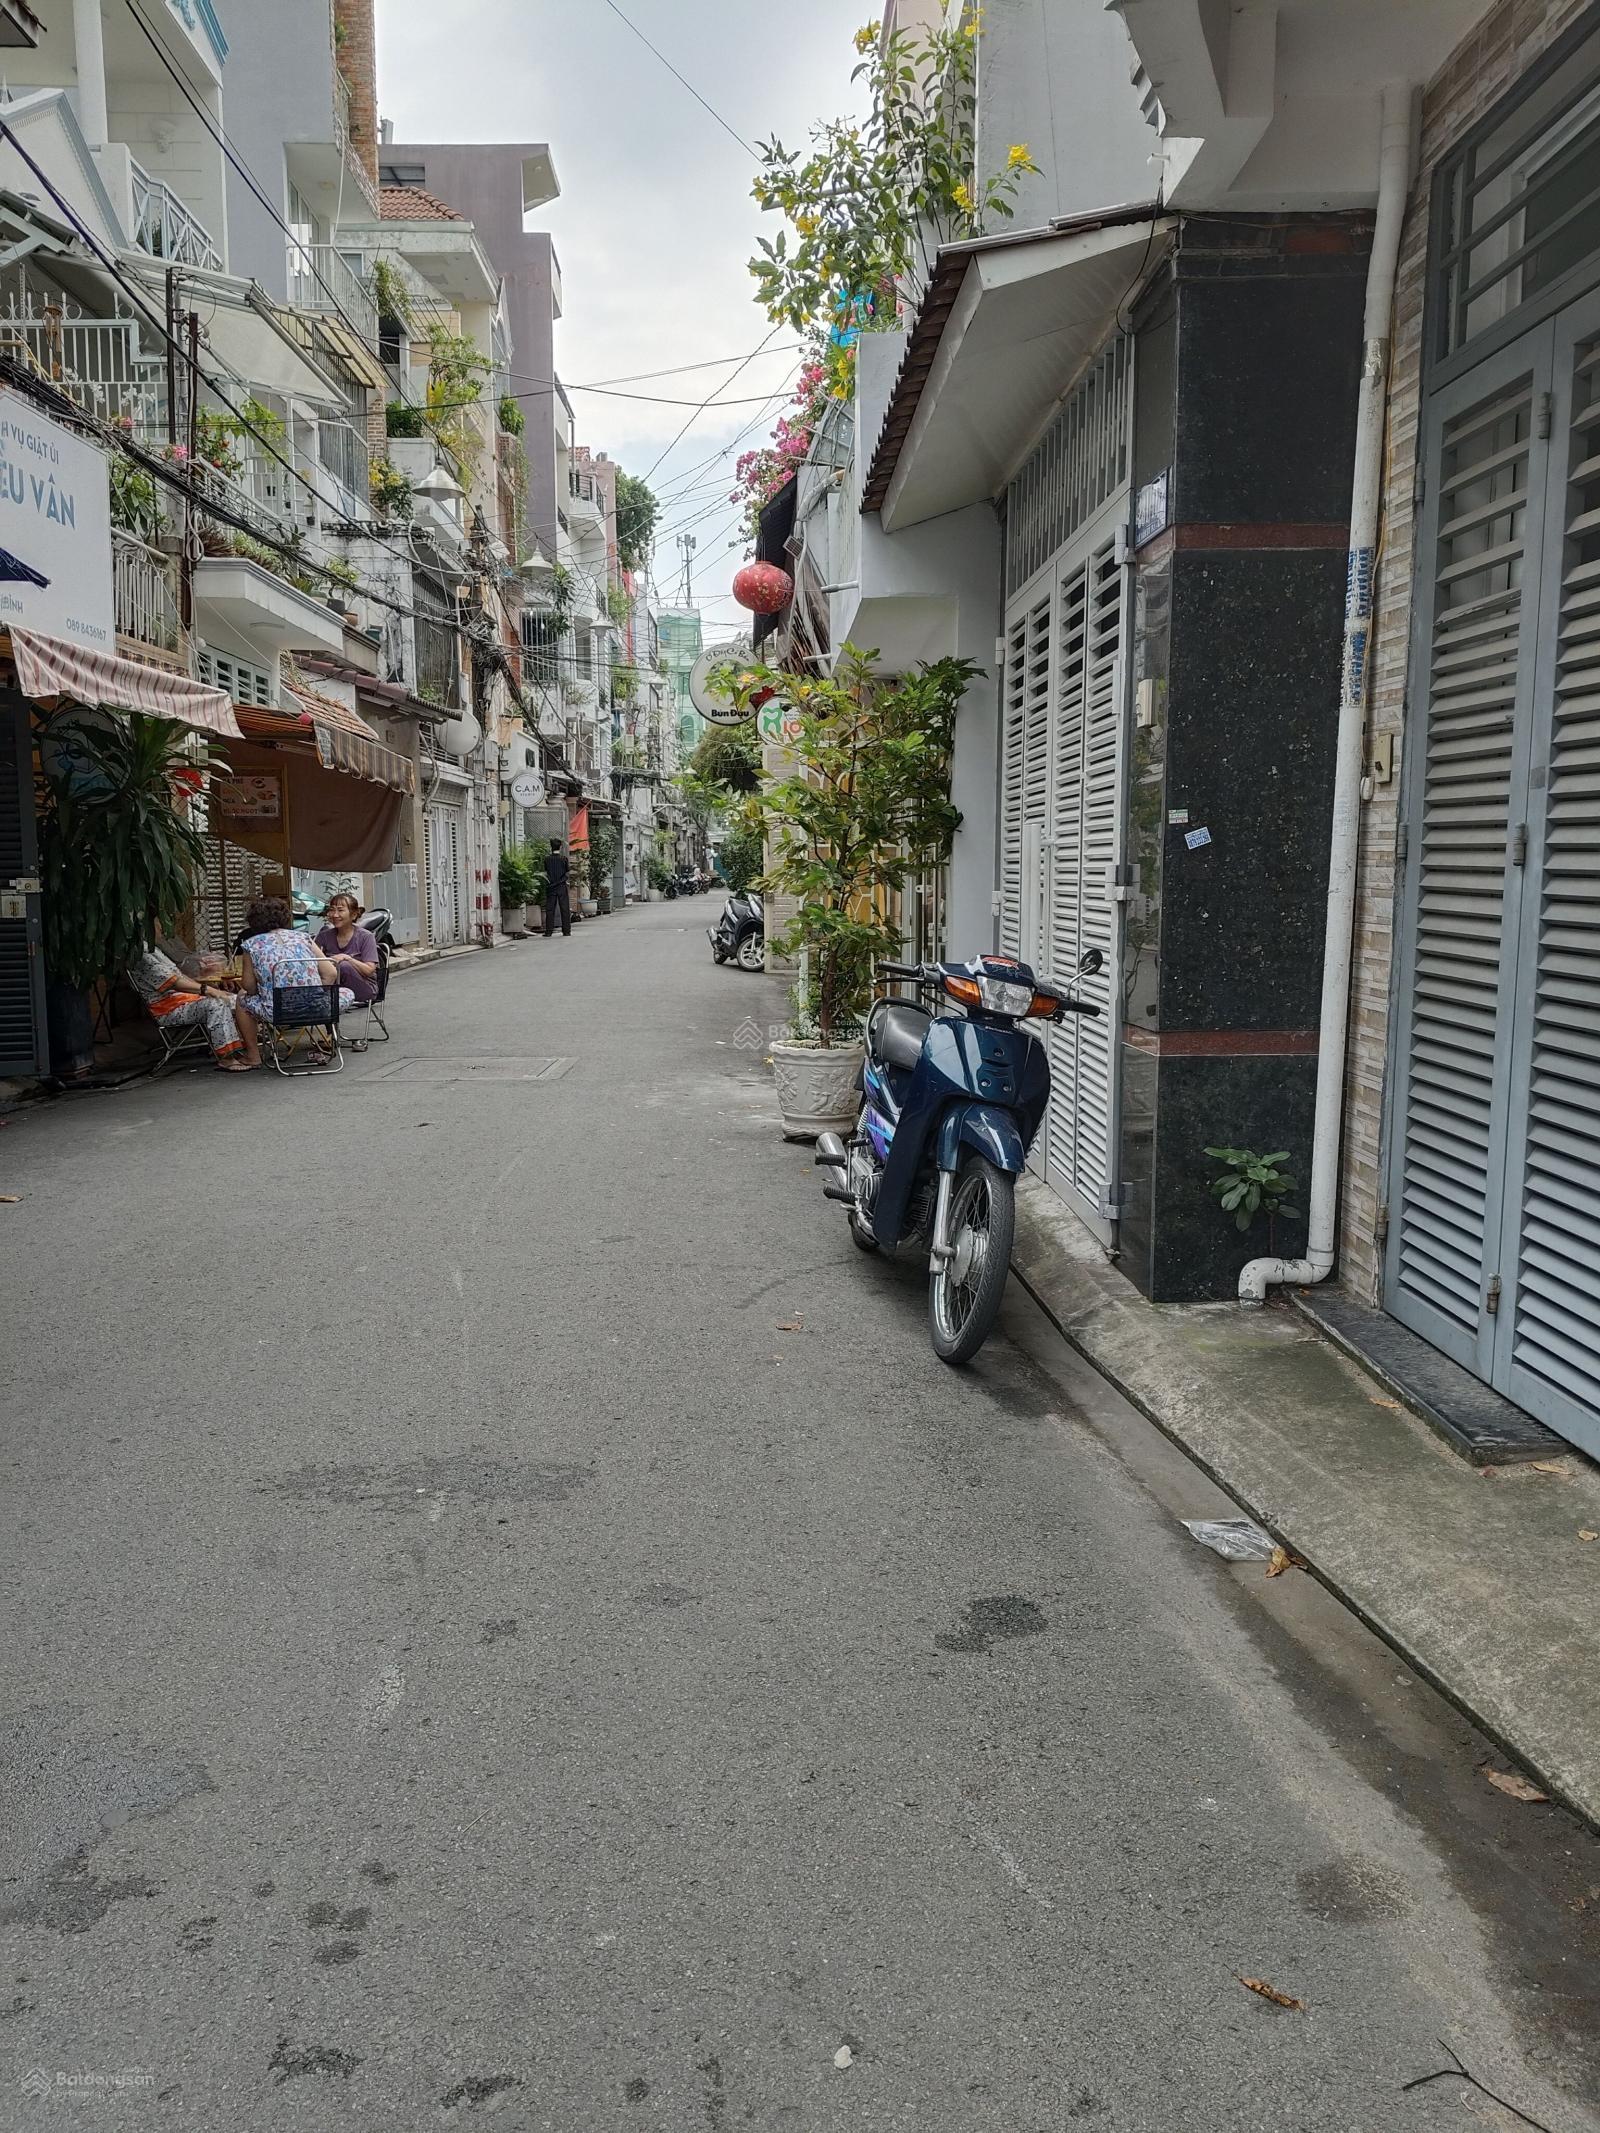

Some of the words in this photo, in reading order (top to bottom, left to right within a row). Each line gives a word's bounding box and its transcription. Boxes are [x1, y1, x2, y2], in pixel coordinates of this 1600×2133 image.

[11, 423, 25, 449] VỤ
[26, 434, 48, 460] GIẬT
[29, 472, 76, 530] VÂN
[66, 618, 80, 632] 089
